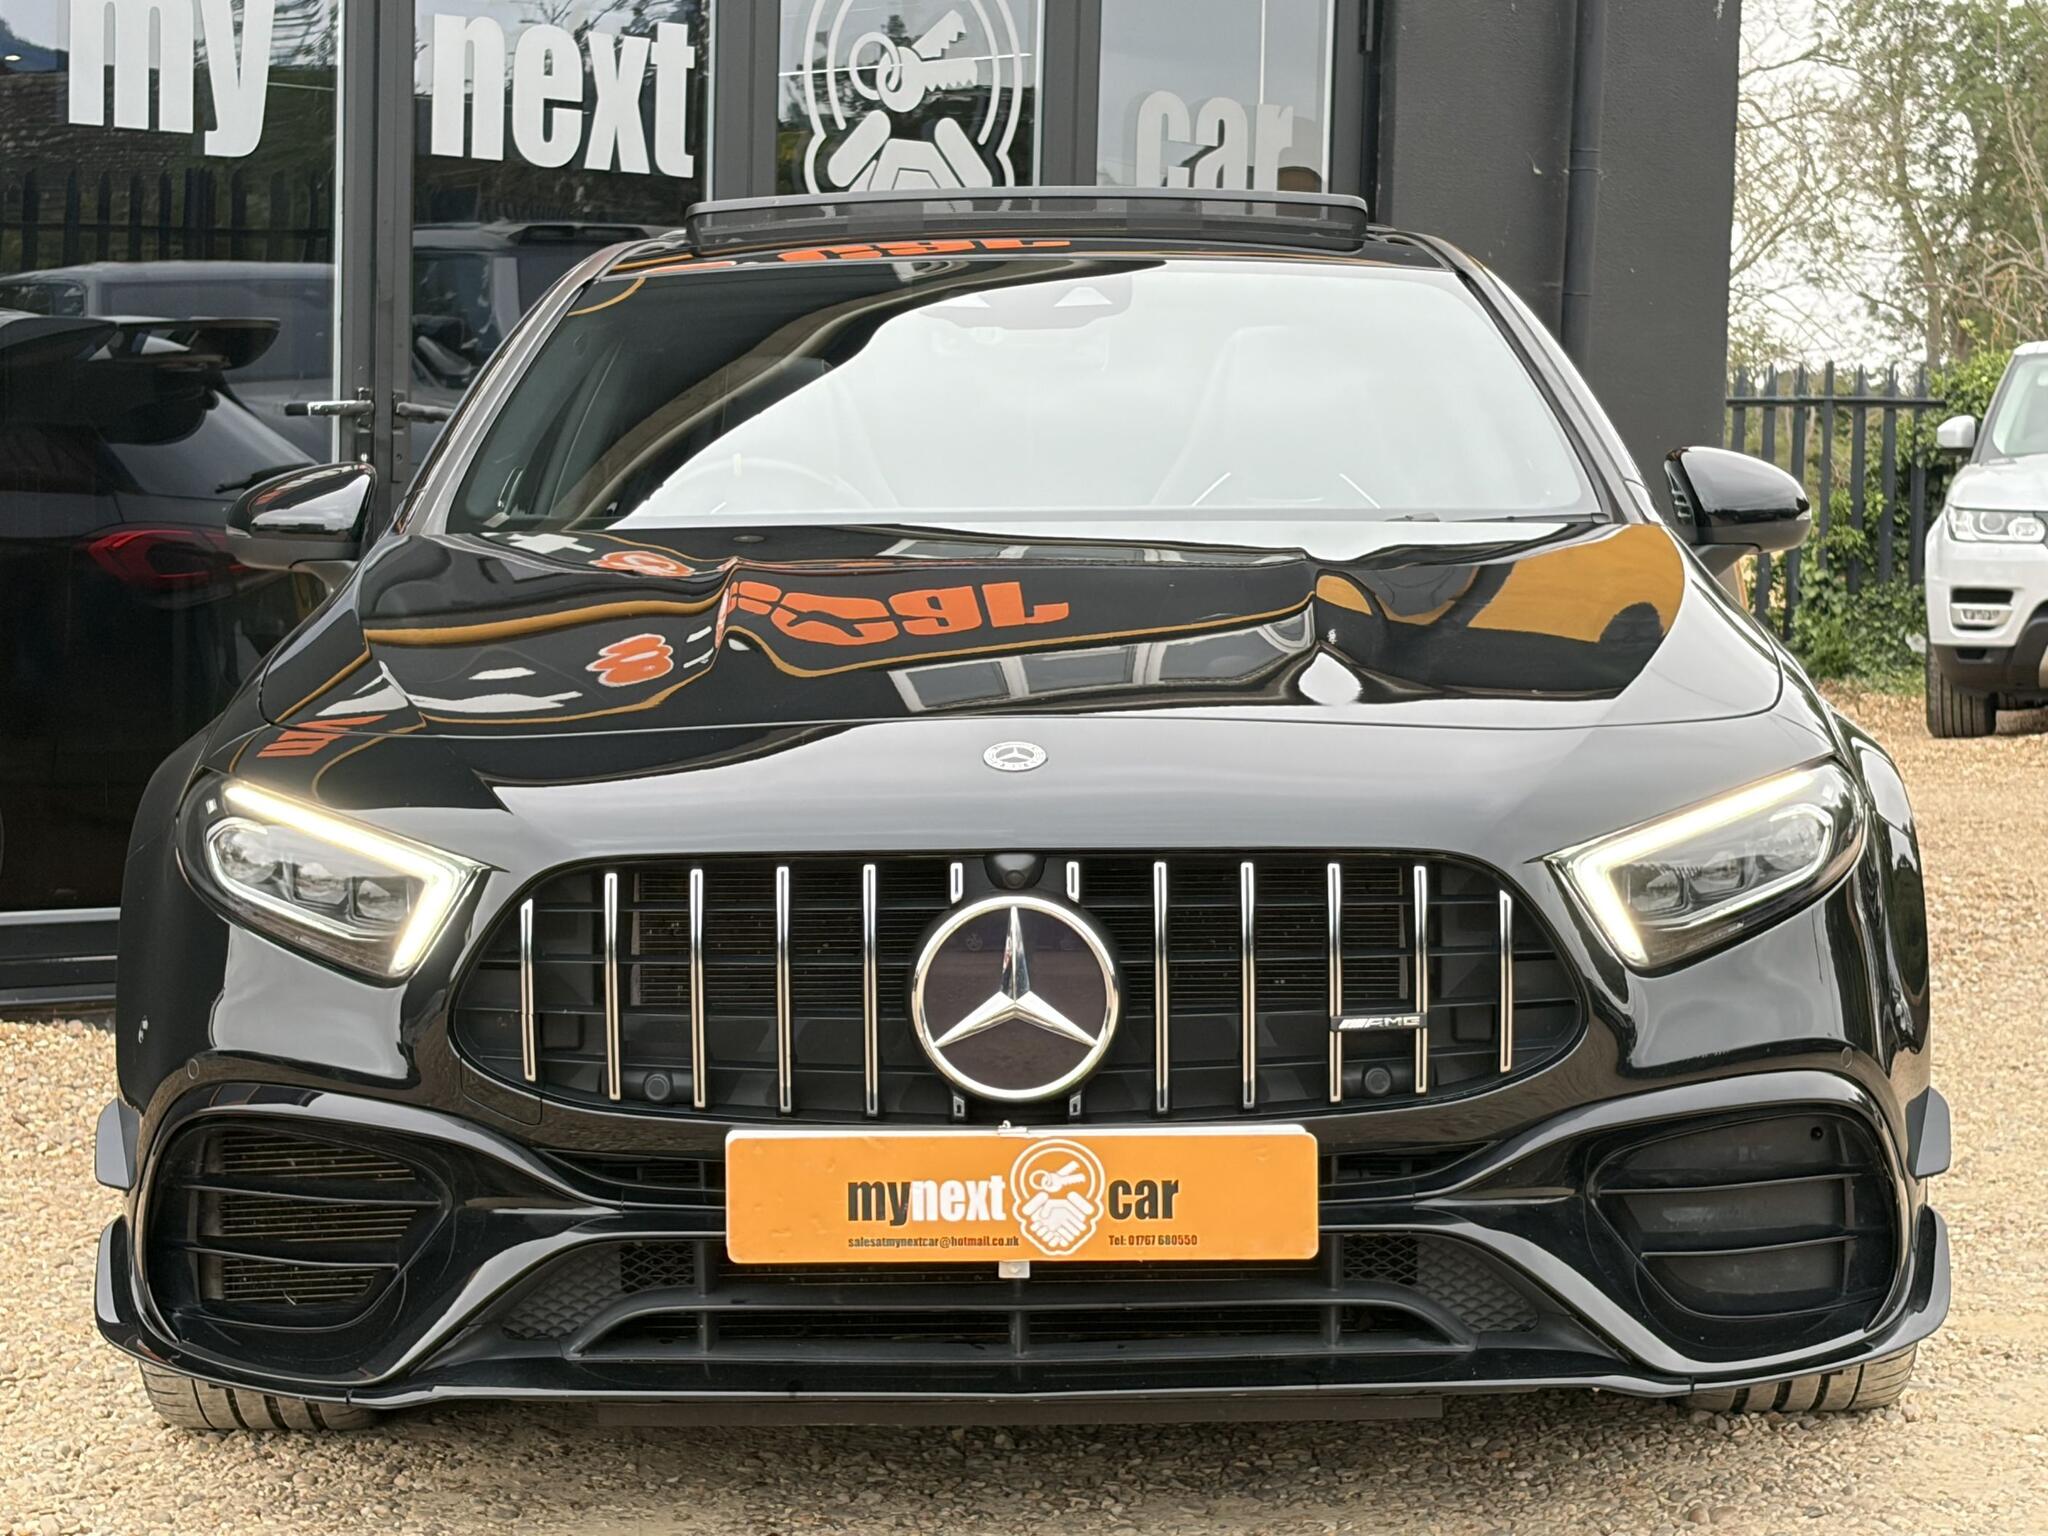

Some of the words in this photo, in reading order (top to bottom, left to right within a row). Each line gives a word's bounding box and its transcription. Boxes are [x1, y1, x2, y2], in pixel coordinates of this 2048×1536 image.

[68, 0, 275, 157] my
[431, 14, 695, 178] next
[1136, 90, 1293, 190] car
[1364, 1016, 1420, 1028] AMG
[1108, 1179, 1179, 1220] car
[848, 1235, 1019, 1248] salesatmynextcar@hotmail.co.uk
[1108, 1235, 1126, 1246] Tel:
[1128, 1235, 1155, 1246] 01767
[1158, 1235, 1198, 1246] 680550
